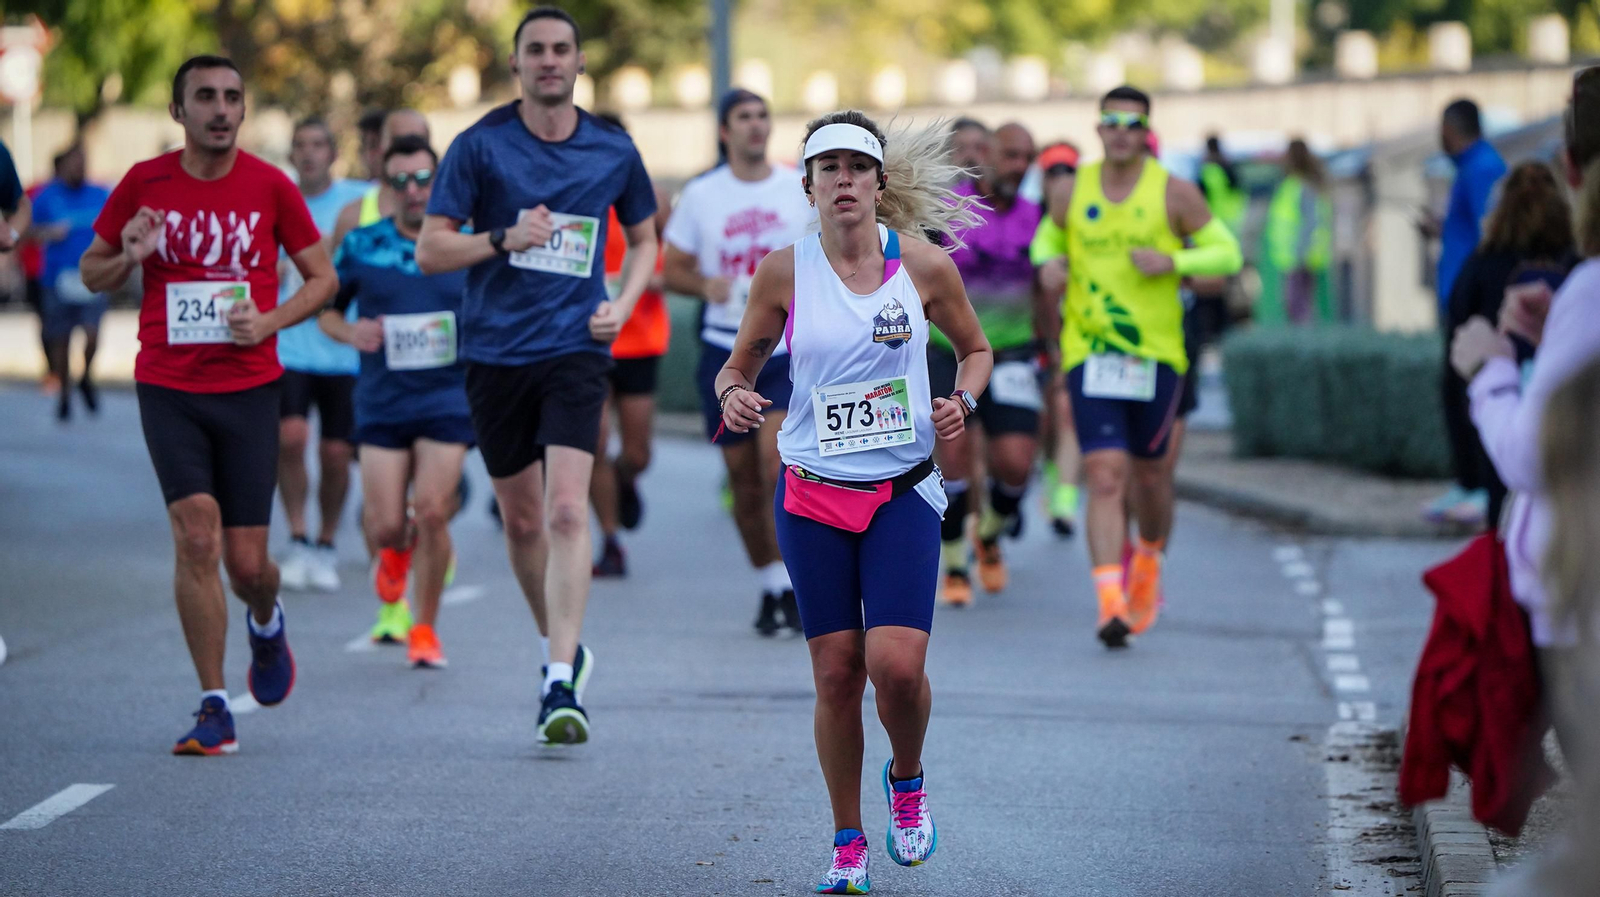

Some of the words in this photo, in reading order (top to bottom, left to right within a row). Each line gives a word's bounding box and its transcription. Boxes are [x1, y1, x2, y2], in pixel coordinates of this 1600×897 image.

[177, 299, 216, 322] 234
[875, 324, 911, 335] PARRA
[827, 400, 874, 431] 573
